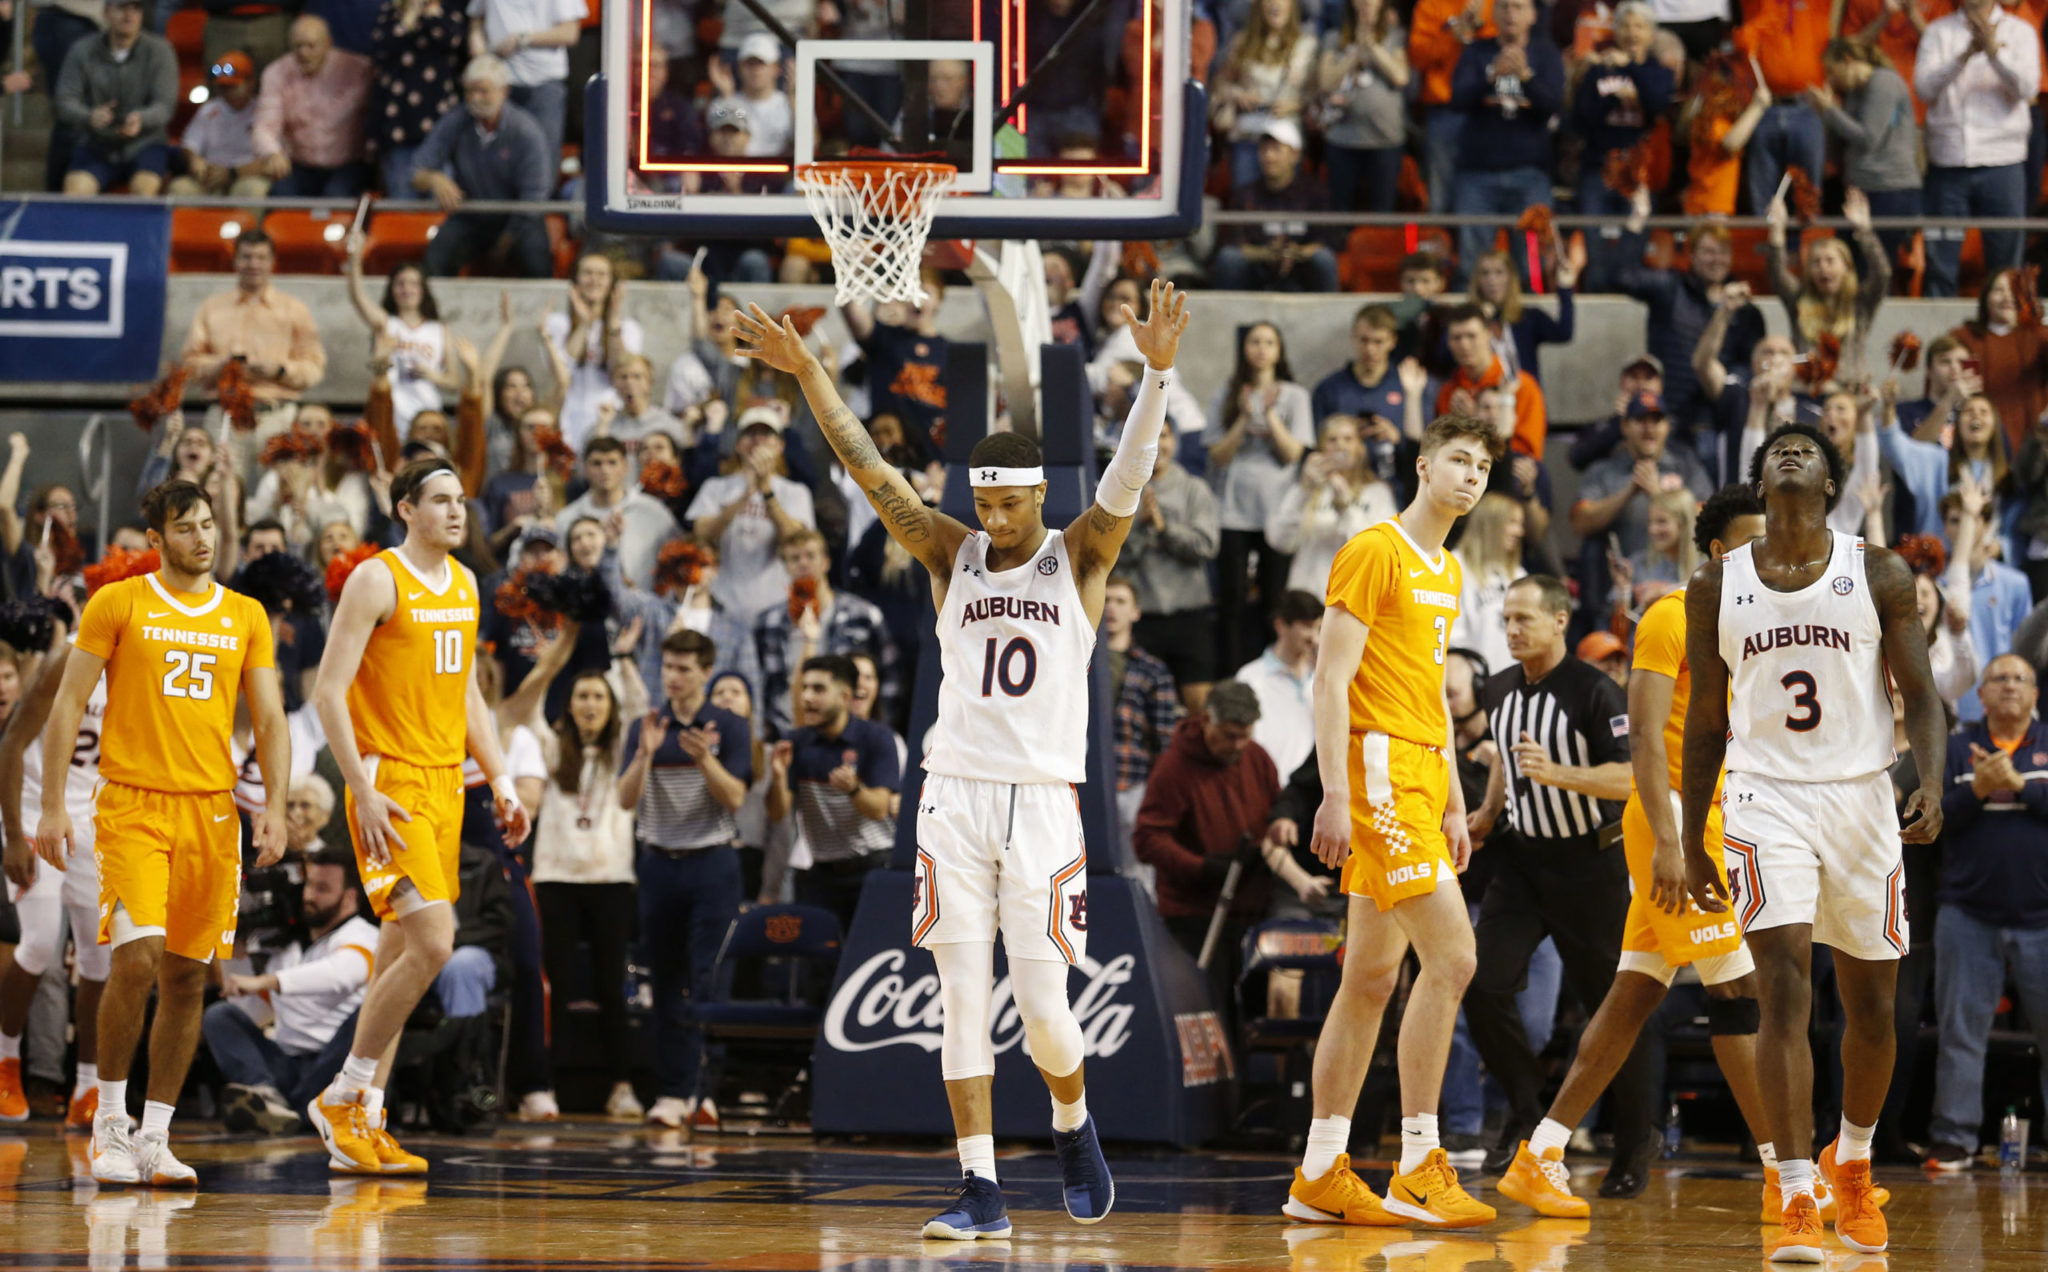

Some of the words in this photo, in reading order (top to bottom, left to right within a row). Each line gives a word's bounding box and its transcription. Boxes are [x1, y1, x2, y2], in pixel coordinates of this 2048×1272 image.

[1039, 558, 1058, 575] SEC
[1833, 577, 1853, 595] SEC
[410, 607, 475, 623] TENNESSEE
[961, 596, 1060, 629] AUBURN
[142, 625, 239, 651] TENNESSEE
[433, 628, 463, 674] 10
[1433, 615, 1447, 665] 3
[1743, 625, 1851, 661] AUBURN
[162, 649, 217, 700] 25
[982, 636, 1037, 698] 10
[1780, 670, 1822, 732] 3
[1386, 862, 1432, 887] VOLS
[1689, 921, 1737, 945] VOLS
[823, 949, 1135, 1058] Coc-la
